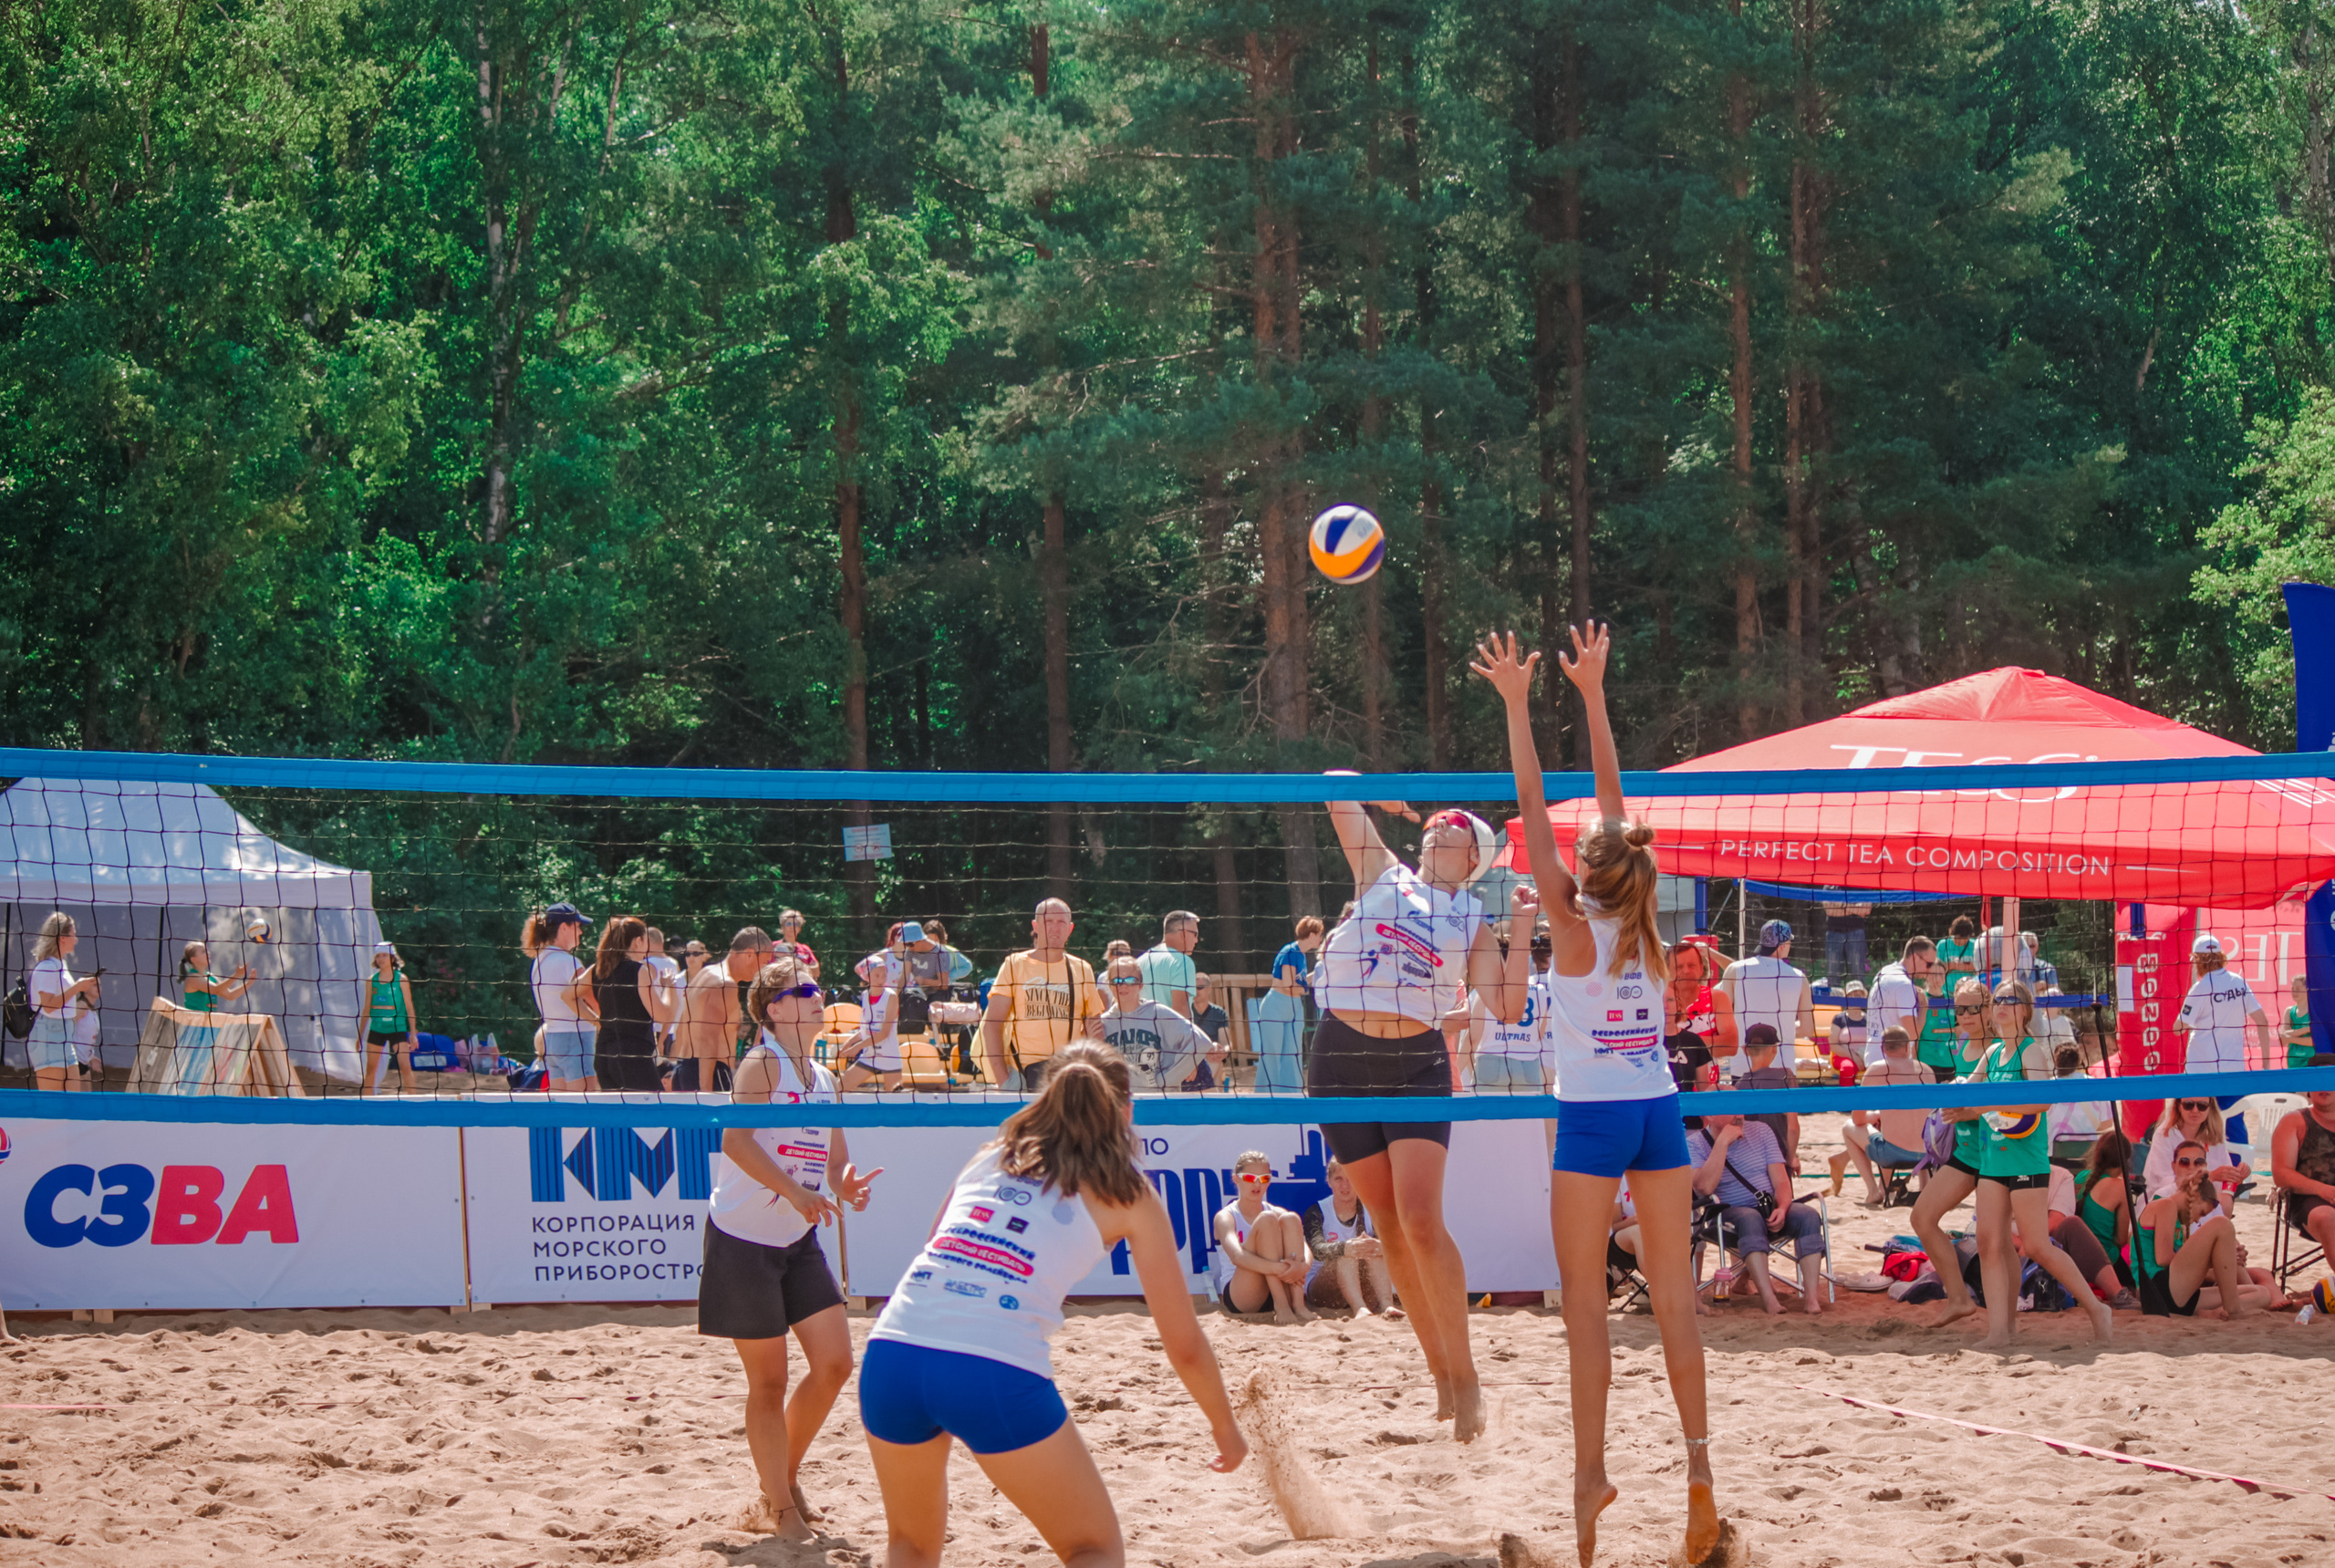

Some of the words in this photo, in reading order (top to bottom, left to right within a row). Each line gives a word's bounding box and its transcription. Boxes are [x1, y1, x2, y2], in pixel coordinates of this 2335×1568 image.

[1721, 839, 1835, 862] PERFECT
[1846, 843, 1894, 865] TEA
[1906, 846, 2109, 875] COMPOSITION
[2137, 953, 2160, 1071] MONDO
[1495, 1032, 1531, 1043] ULTRAS
[533, 1215, 695, 1233] КОРПОРАЦИЯ
[534, 1238, 666, 1258] МОРСКОГО
